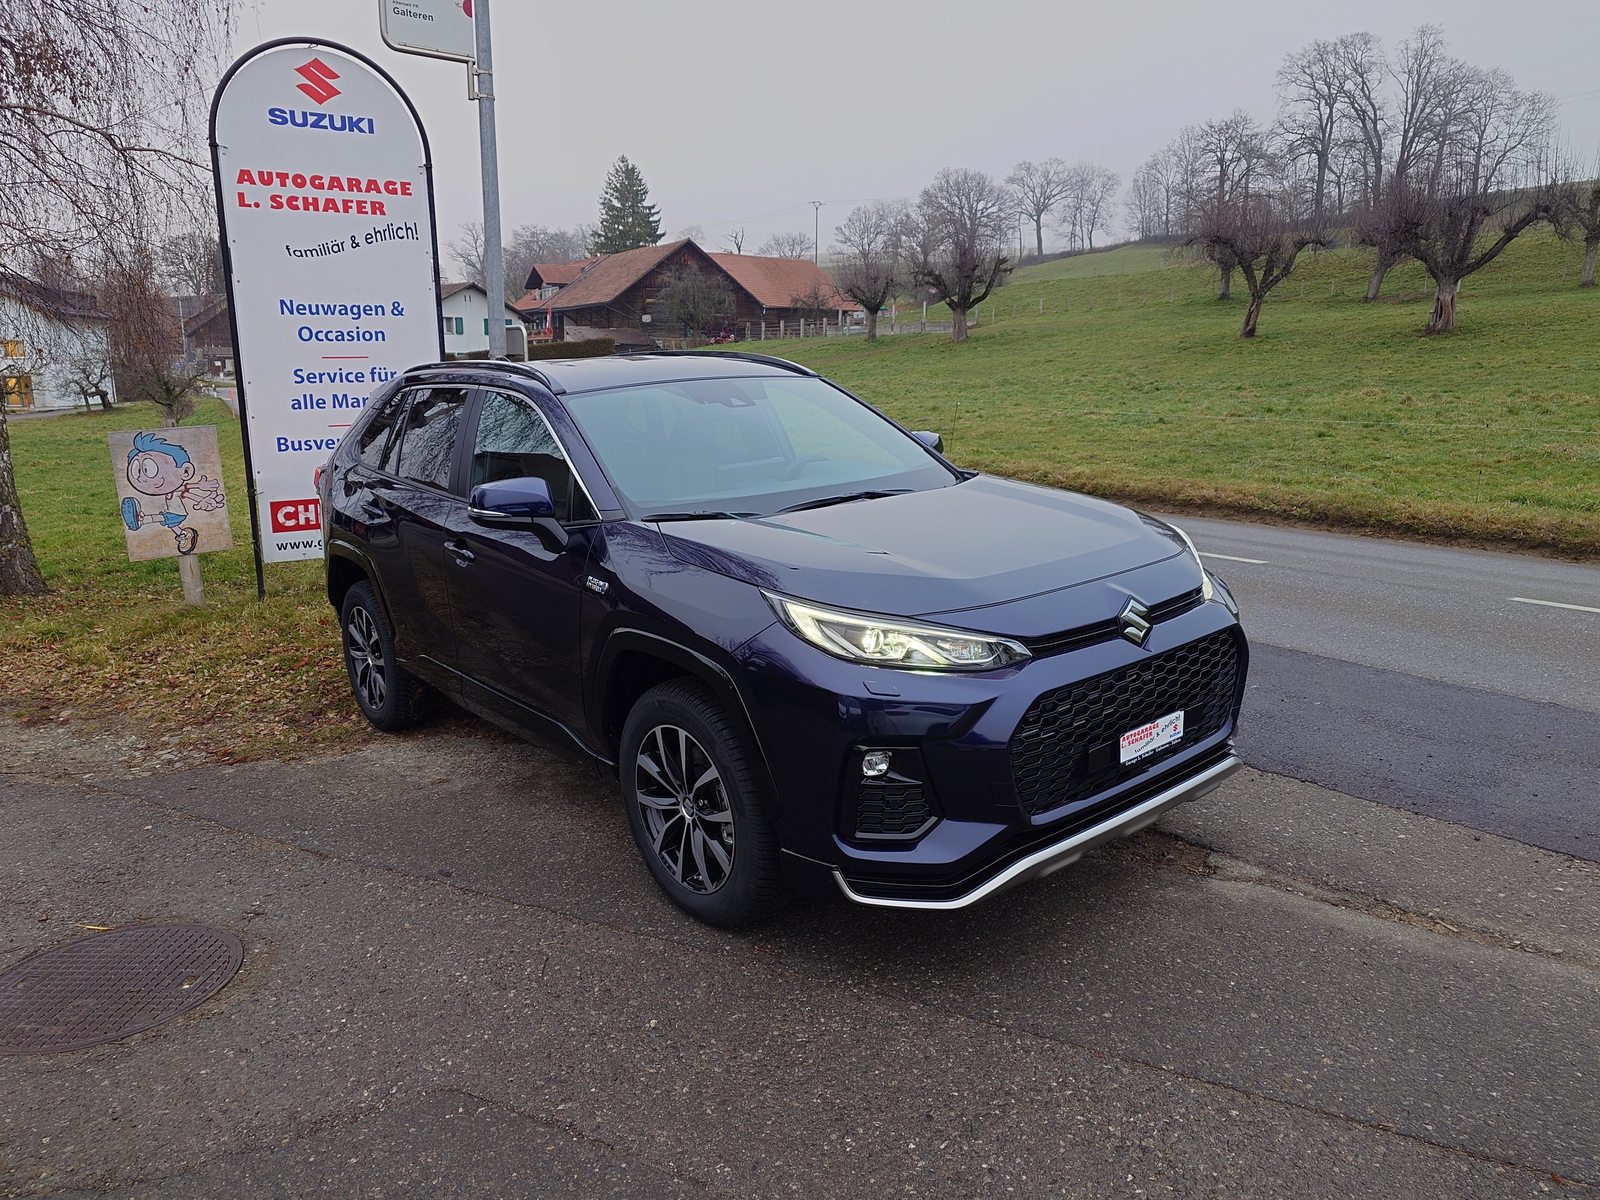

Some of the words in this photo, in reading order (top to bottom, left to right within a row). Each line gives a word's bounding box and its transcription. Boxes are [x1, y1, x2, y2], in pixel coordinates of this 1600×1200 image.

[392, 6, 434, 21] Galteren
[267, 107, 375, 134] SUZUKI
[236, 169, 413, 197] AUTOGARAGE
[237, 192, 261, 209] L.
[269, 194, 387, 216] SCHAFER
[286, 239, 346, 258] familiär
[350, 235, 361, 250] &
[364, 221, 420, 245] ehrlich!
[279, 298, 386, 320] Neuwagen
[390, 301, 405, 317] &
[297, 326, 386, 342] Occasion
[293, 368, 365, 384] Service
[369, 367, 397, 383] für
[291, 393, 327, 410] alle
[332, 392, 371, 409] Mar
[276, 436, 340, 452] Busve
[1121, 722, 1160, 743] AUTOGARAGE
[1127, 731, 1153, 747] SCHAFER
